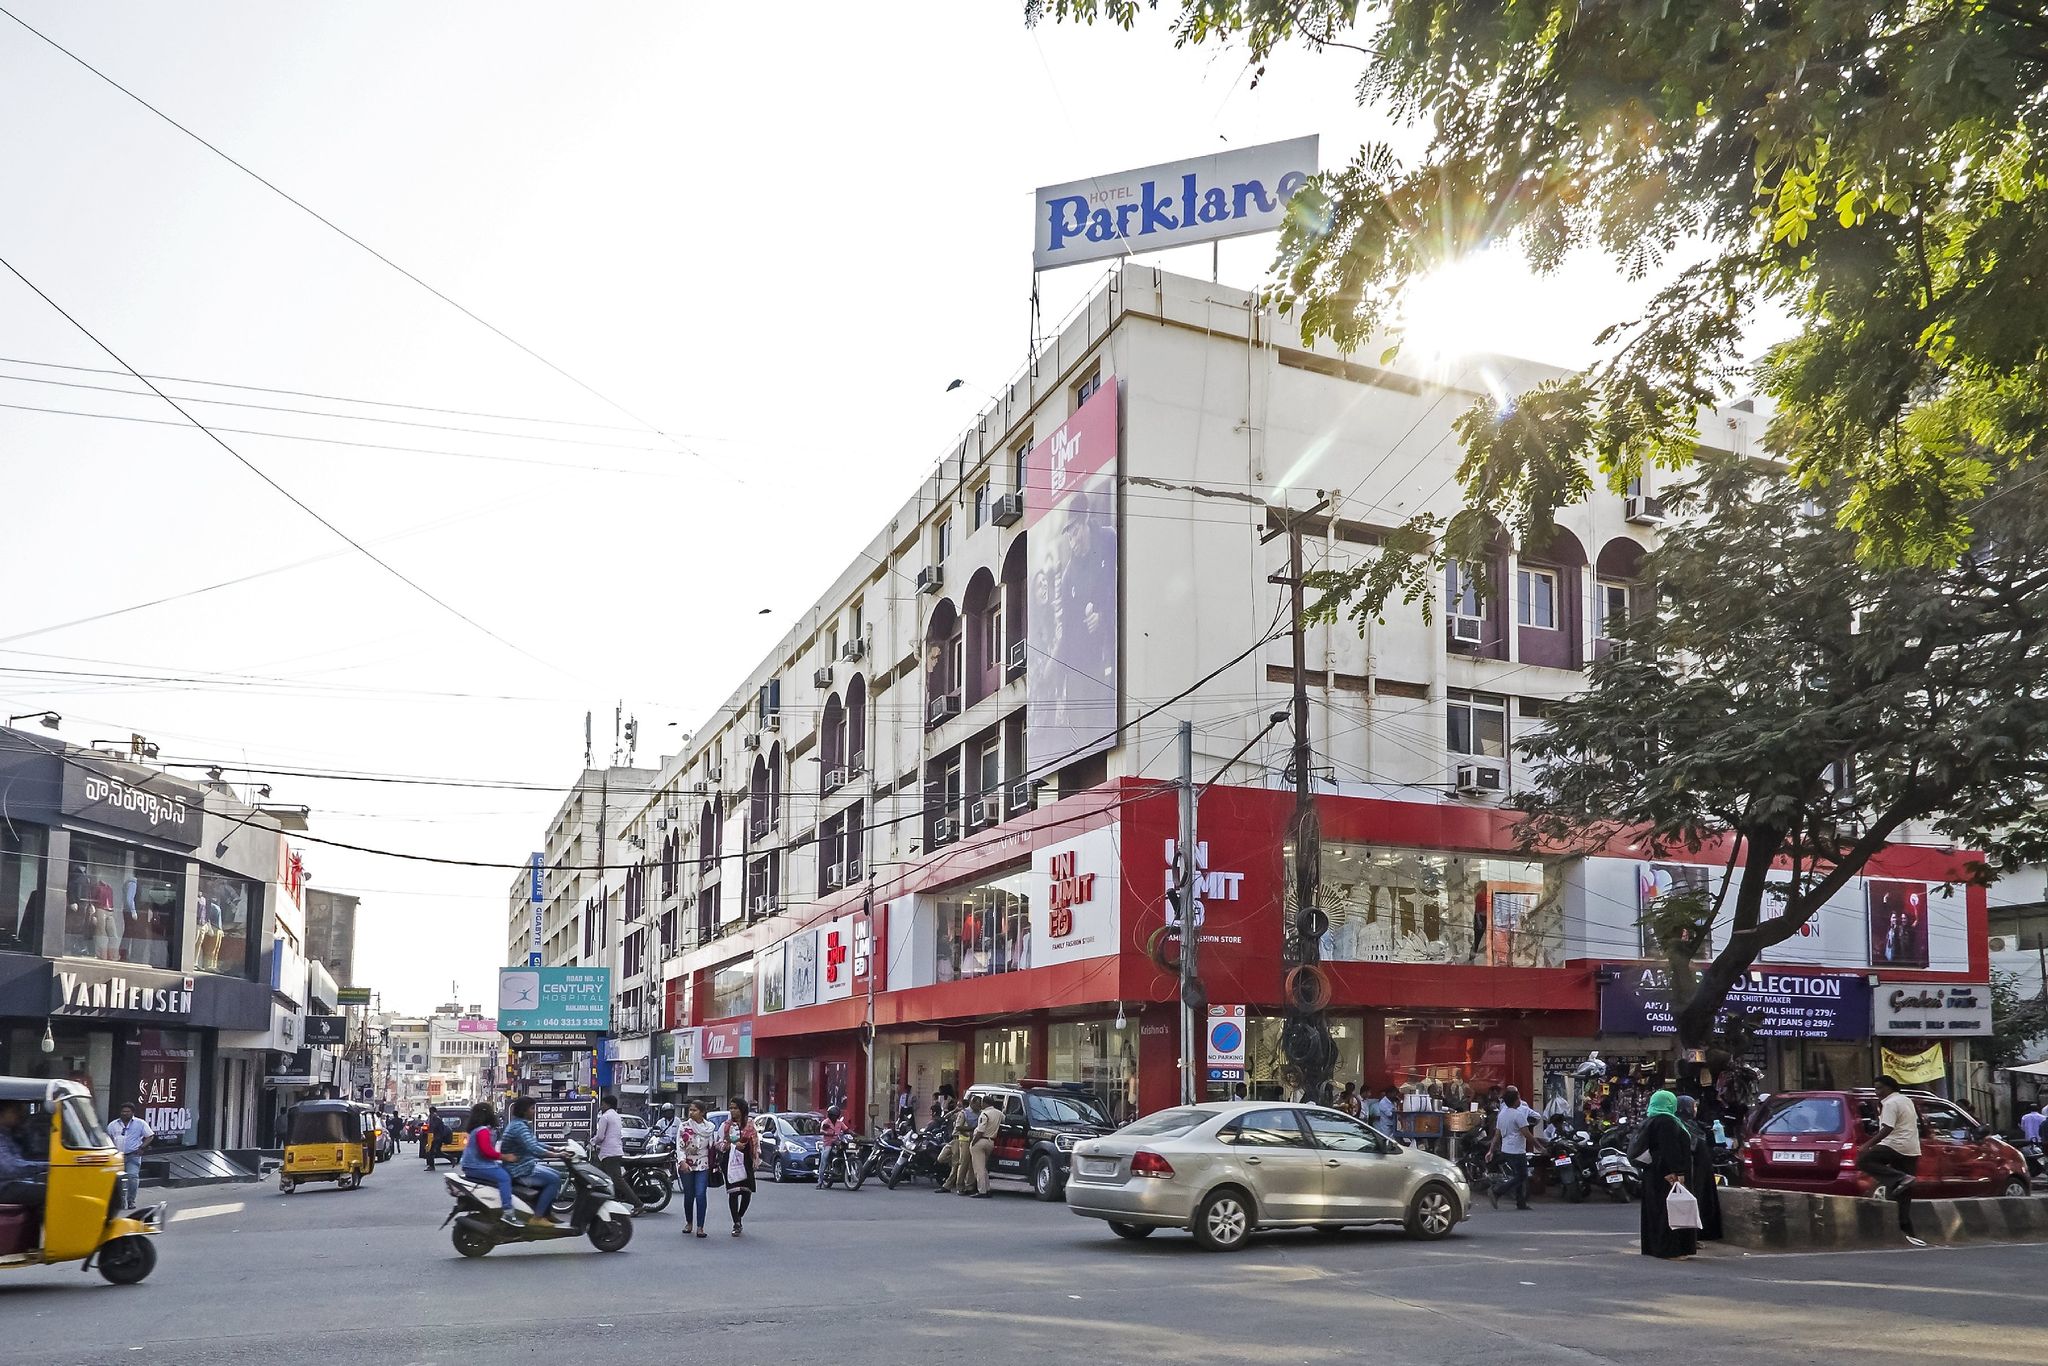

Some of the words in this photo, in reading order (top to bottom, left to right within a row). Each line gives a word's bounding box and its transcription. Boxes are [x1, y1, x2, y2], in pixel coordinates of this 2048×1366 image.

[1090, 187, 1133, 204] HOTEL
[1051, 425, 1068, 455] UN
[1049, 850, 1076, 881] UN
[1049, 873, 1095, 910] LIMIT
[535, 907, 543, 946] GIGABYTE
[1052, 942, 1065, 950] FAMILY
[1065, 938, 1082, 947] FASHION
[1082, 936, 1095, 944] STORE
[567, 975, 583, 983] ROAD
[597, 975, 604, 983] 12
[543, 983, 603, 994] CENTURY
[543, 994, 604, 1002] HOSPITAL
[1764, 995, 1791, 1004] MAKER
[1780, 1007, 1805, 1016] SHIRT
[1814, 1009, 1837, 1017] 279/-
[543, 1018, 559, 1026] 040
[560, 1018, 581, 1026] 3313
[583, 1018, 603, 1026] 3333
[1777, 1018, 1803, 1027] JEANS
[1812, 1019, 1835, 1028] 299/-
[1140, 1024, 1169, 1035] Krishna's
[1800, 1030, 1828, 1038] T-SHIRTS
[1221, 1070, 1240, 1079] SBI
[138, 1078, 177, 1104] SALE
